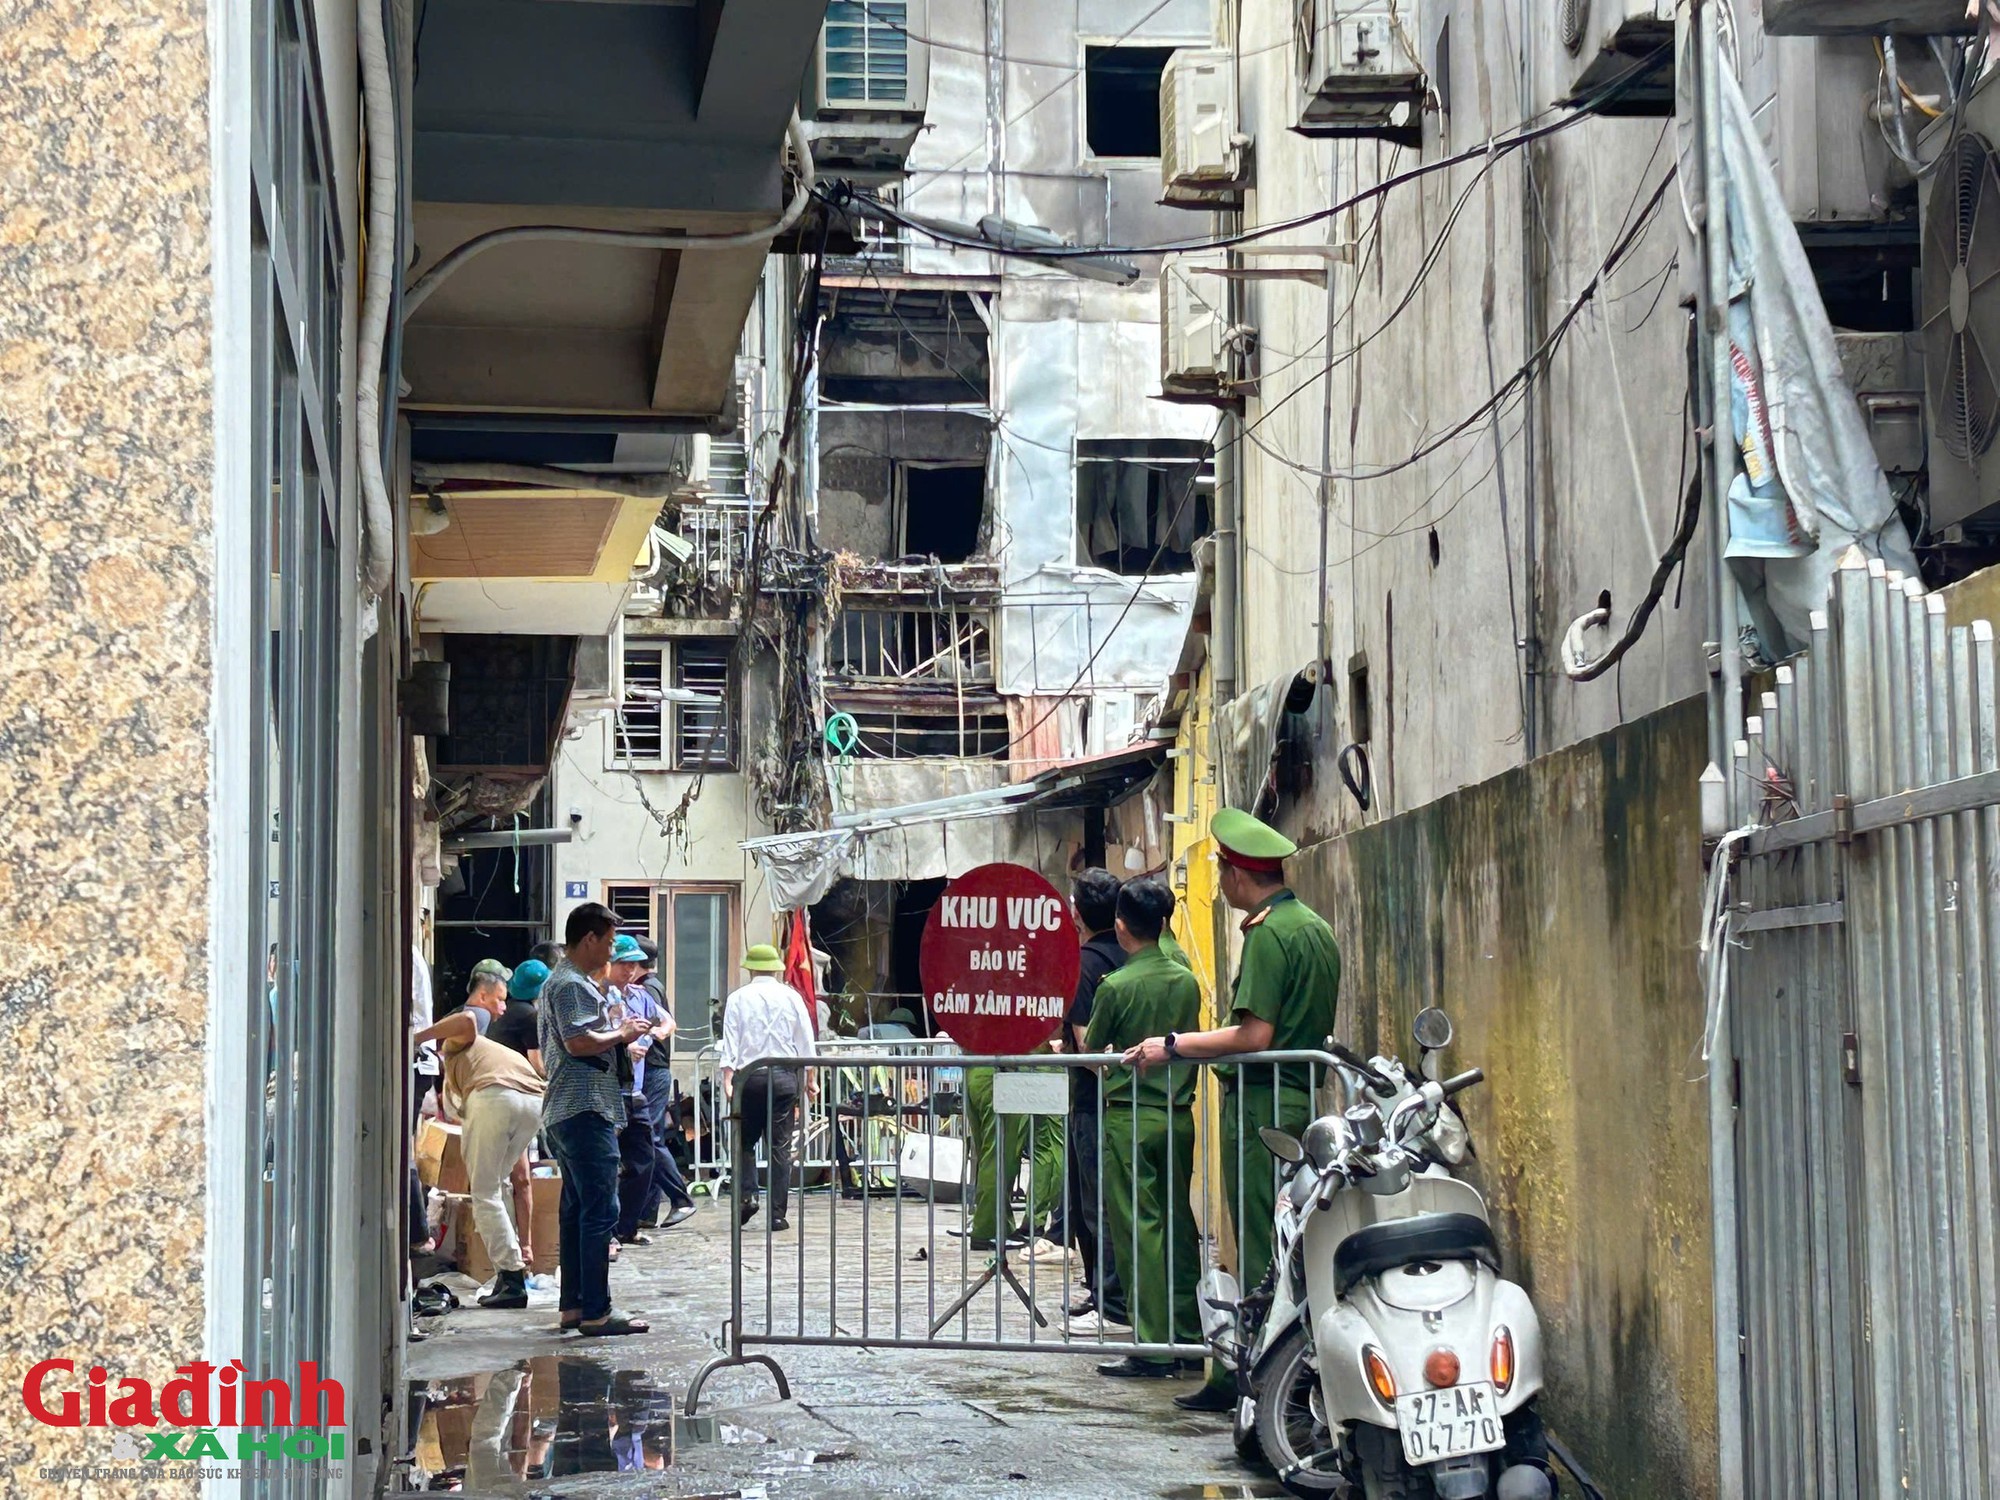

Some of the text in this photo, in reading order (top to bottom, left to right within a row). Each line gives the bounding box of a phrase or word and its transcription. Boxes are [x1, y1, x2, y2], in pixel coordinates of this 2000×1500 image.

[941, 895, 1062, 939] KHU VỰC
[970, 942, 1027, 977] BẢO VỆ
[933, 983, 1064, 1021] CẤM XÂM PHẠM
